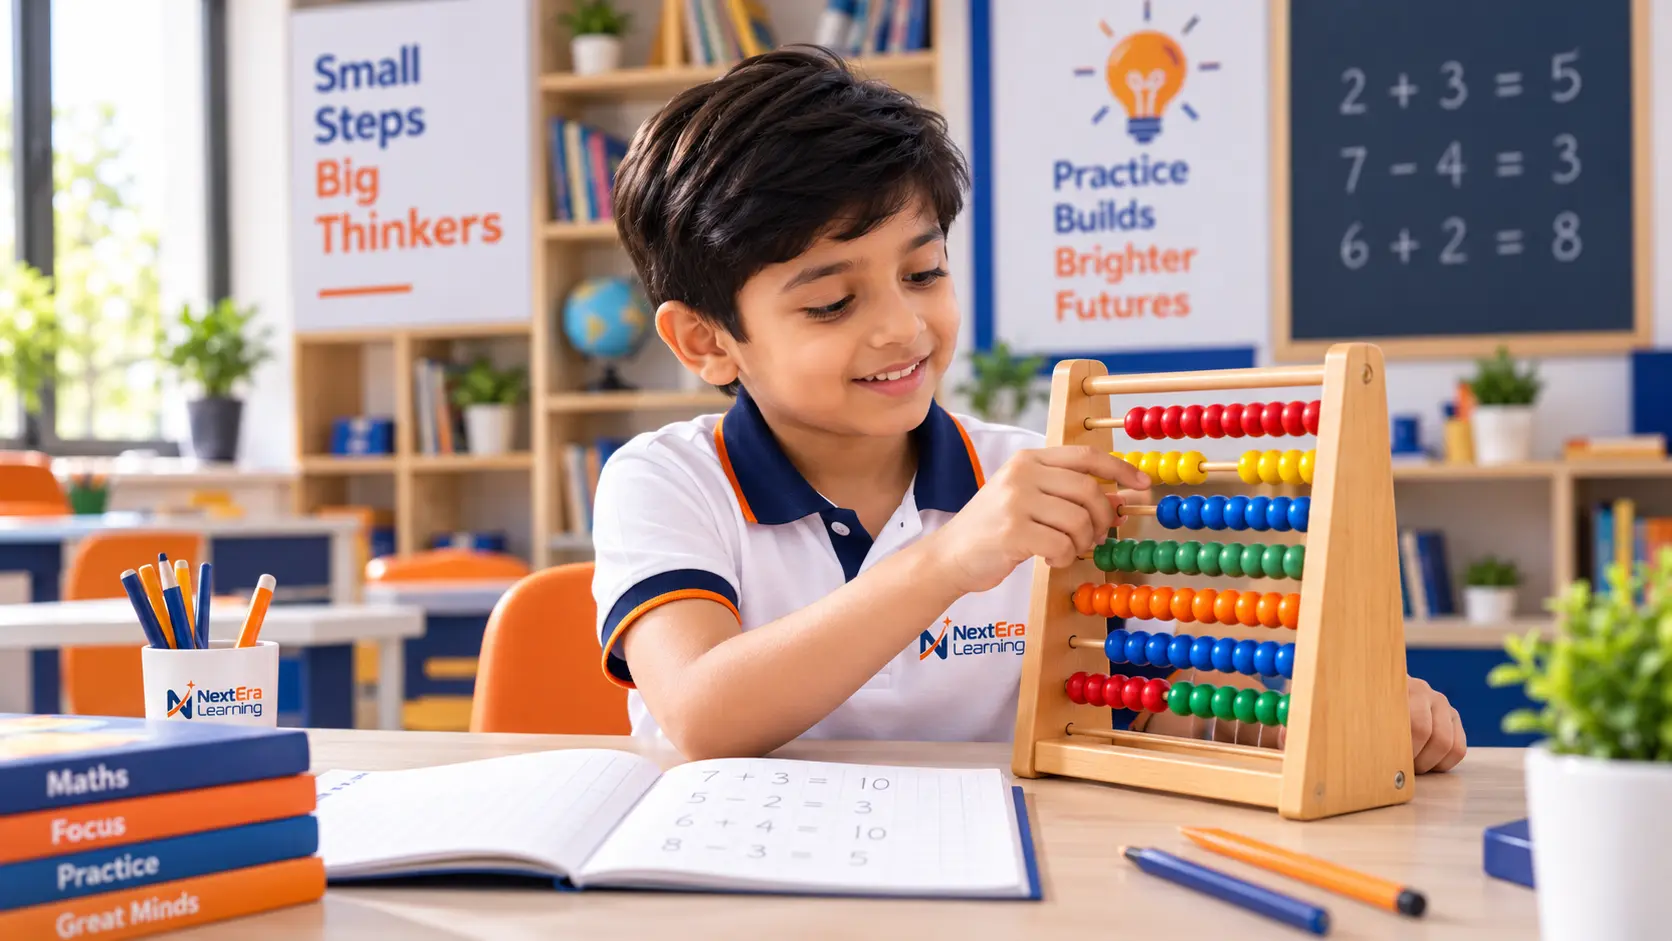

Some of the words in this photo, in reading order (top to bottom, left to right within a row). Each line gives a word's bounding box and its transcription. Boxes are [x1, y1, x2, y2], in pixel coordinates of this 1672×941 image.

[314, 44, 421, 94] Small
[1339, 67, 1366, 115] 2
[1390, 74, 1416, 107] +
[1439, 60, 1468, 110] 3
[1495, 71, 1522, 97] =
[1551, 51, 1582, 103] 5
[315, 105, 426, 150] Steps
[1053, 154, 1190, 191] Practice
[1341, 146, 1368, 193] 7
[1436, 141, 1464, 186] 4
[1496, 151, 1523, 177] =
[1552, 133, 1582, 184] 3
[316, 158, 379, 207] Big
[315, 207, 503, 254] Thinkers
[1053, 199, 1156, 235] Builds
[1340, 224, 1369, 269] 6
[1391, 231, 1418, 262] +
[1439, 216, 1467, 265] 2
[1496, 229, 1523, 255] =
[1552, 211, 1582, 261] 8
[1054, 243, 1196, 285] Brighter
[1055, 290, 1191, 322] Futures
[953, 621, 1026, 641] NextEra
[953, 639, 1026, 656] Learning
[198, 687, 262, 703] NextEra
[198, 701, 262, 717] Learning
[46, 764, 129, 797] Maths
[703, 770, 720, 782] 7
[772, 773, 789, 784] 3
[862, 777, 889, 790] 10
[690, 792, 706, 803] 5
[763, 796, 782, 807] 2
[855, 801, 872, 814] 3
[51, 816, 126, 844] Focus
[675, 814, 693, 827] 6
[756, 820, 773, 833] 4
[856, 825, 886, 840] 10
[661, 838, 682, 851] 8
[748, 845, 766, 858] 3
[850, 851, 868, 866] 5
[57, 855, 160, 890] Practice
[56, 904, 125, 938] Great
[131, 892, 199, 924] Minds
